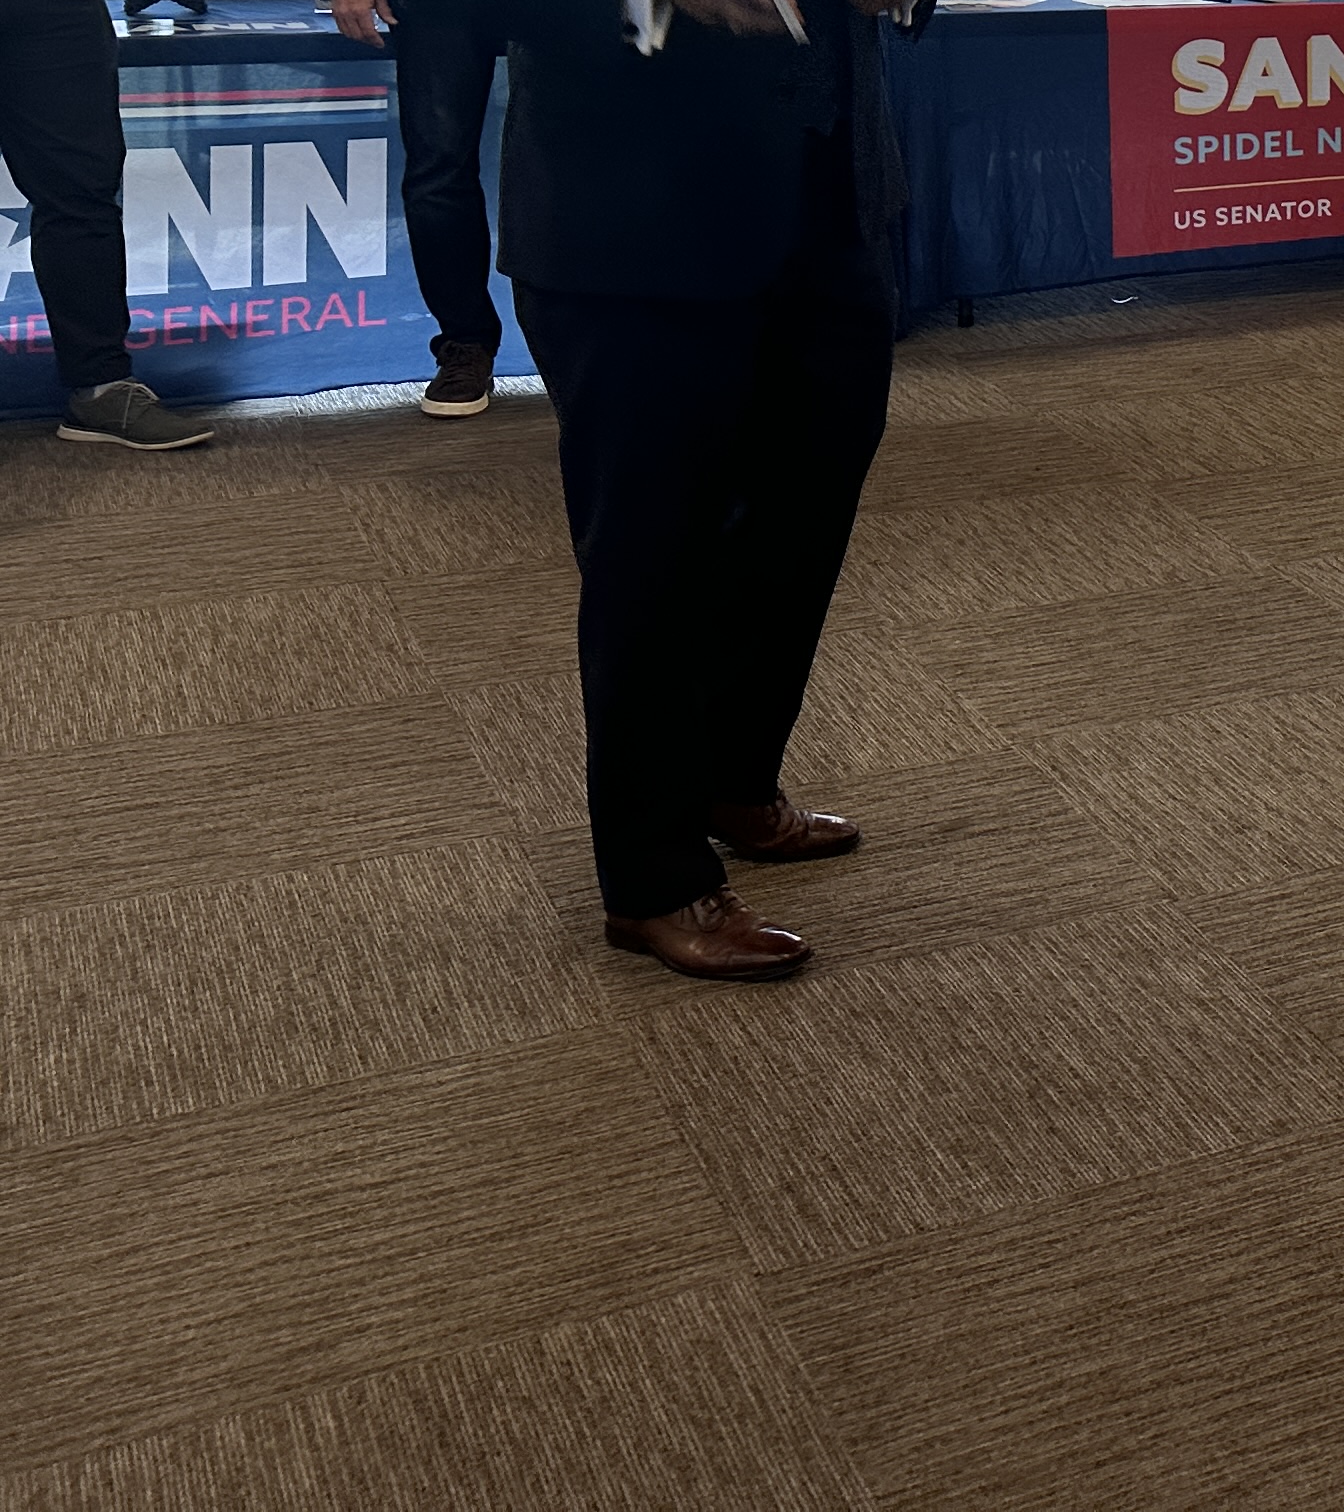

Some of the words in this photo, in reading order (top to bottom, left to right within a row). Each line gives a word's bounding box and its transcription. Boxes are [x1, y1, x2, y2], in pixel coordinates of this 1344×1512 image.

[1173, 131, 1304, 165] SPIDEL
[0, 138, 388, 302] NN
[1174, 209, 1206, 229] US
[1215, 198, 1333, 226] SENATOR
[123, 290, 387, 350] GENERAL
